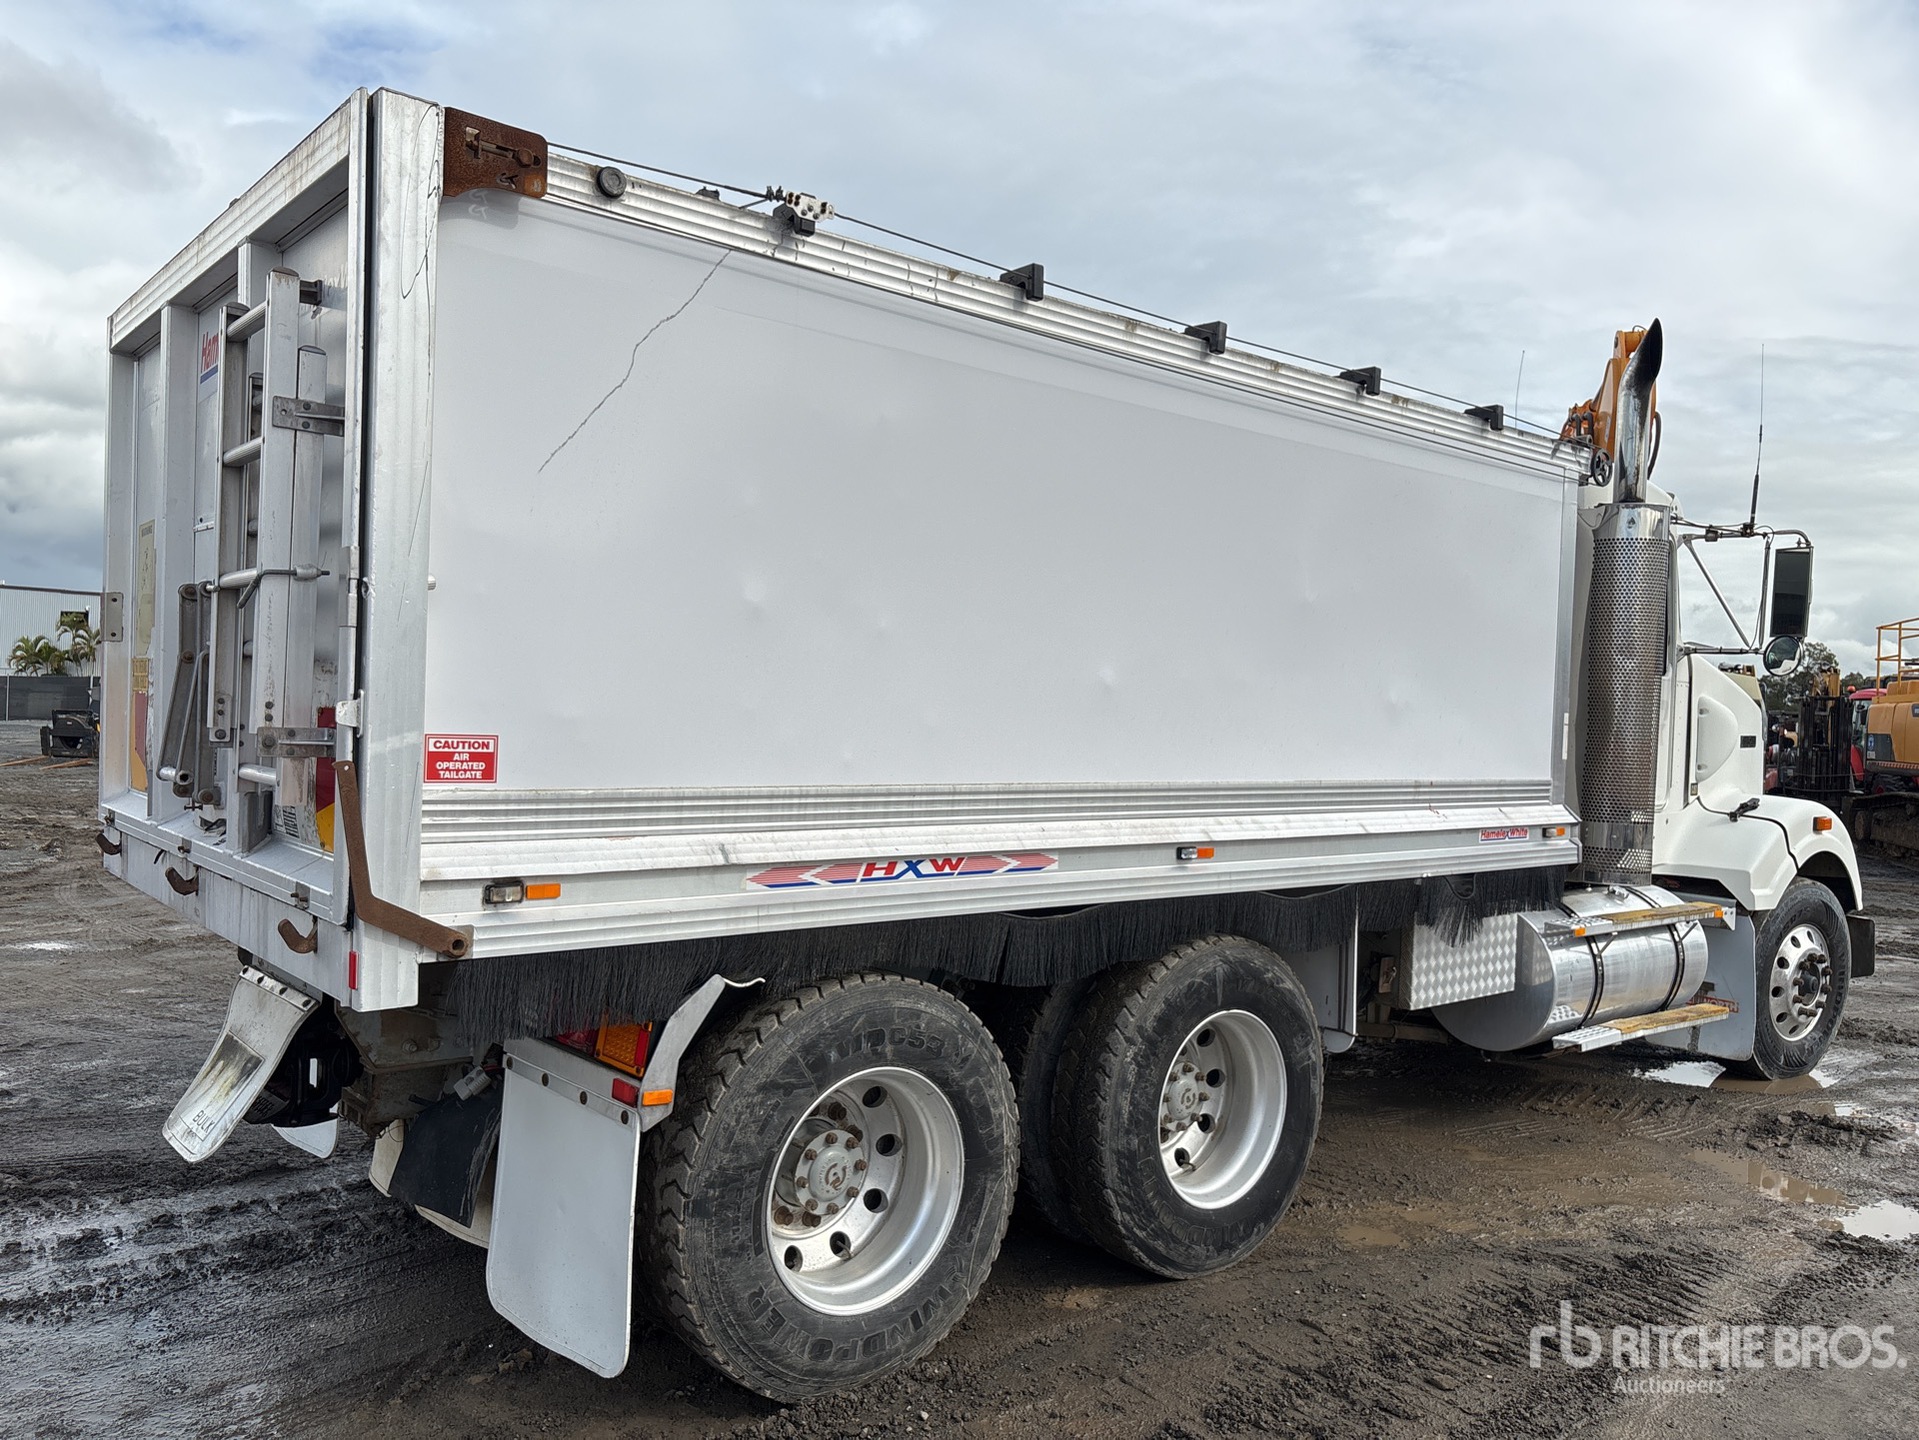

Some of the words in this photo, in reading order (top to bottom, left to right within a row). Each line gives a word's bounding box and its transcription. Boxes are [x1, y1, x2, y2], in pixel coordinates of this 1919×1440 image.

[433, 740, 490, 750] CAUTION
[453, 752, 470, 761] AIR
[436, 761, 486, 770] OPERATED
[438, 770, 482, 779] TAILGATE
[863, 857, 964, 879] HXW
[192, 1109, 216, 1134] BULK
